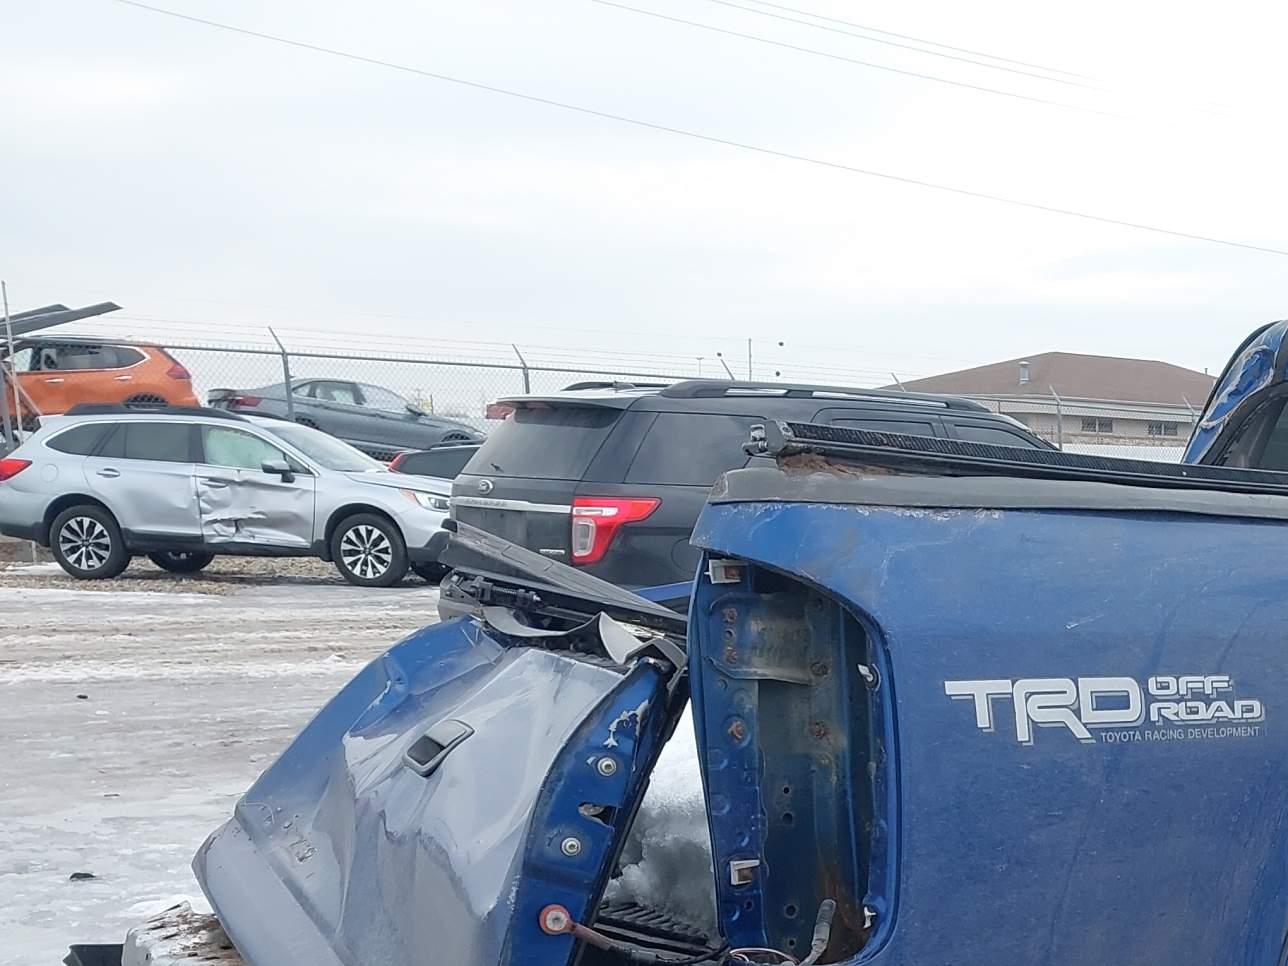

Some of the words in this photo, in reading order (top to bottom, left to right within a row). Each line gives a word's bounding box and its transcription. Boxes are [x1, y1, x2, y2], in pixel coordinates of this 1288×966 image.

[1147, 675, 1233, 699] OFF
[944, 676, 1146, 745] TRD
[1149, 699, 1266, 726] ROAD
[1100, 731, 1143, 743] TOYOTA
[1144, 729, 1185, 742] RACING
[1187, 725, 1261, 740] DEVELOPMENT
